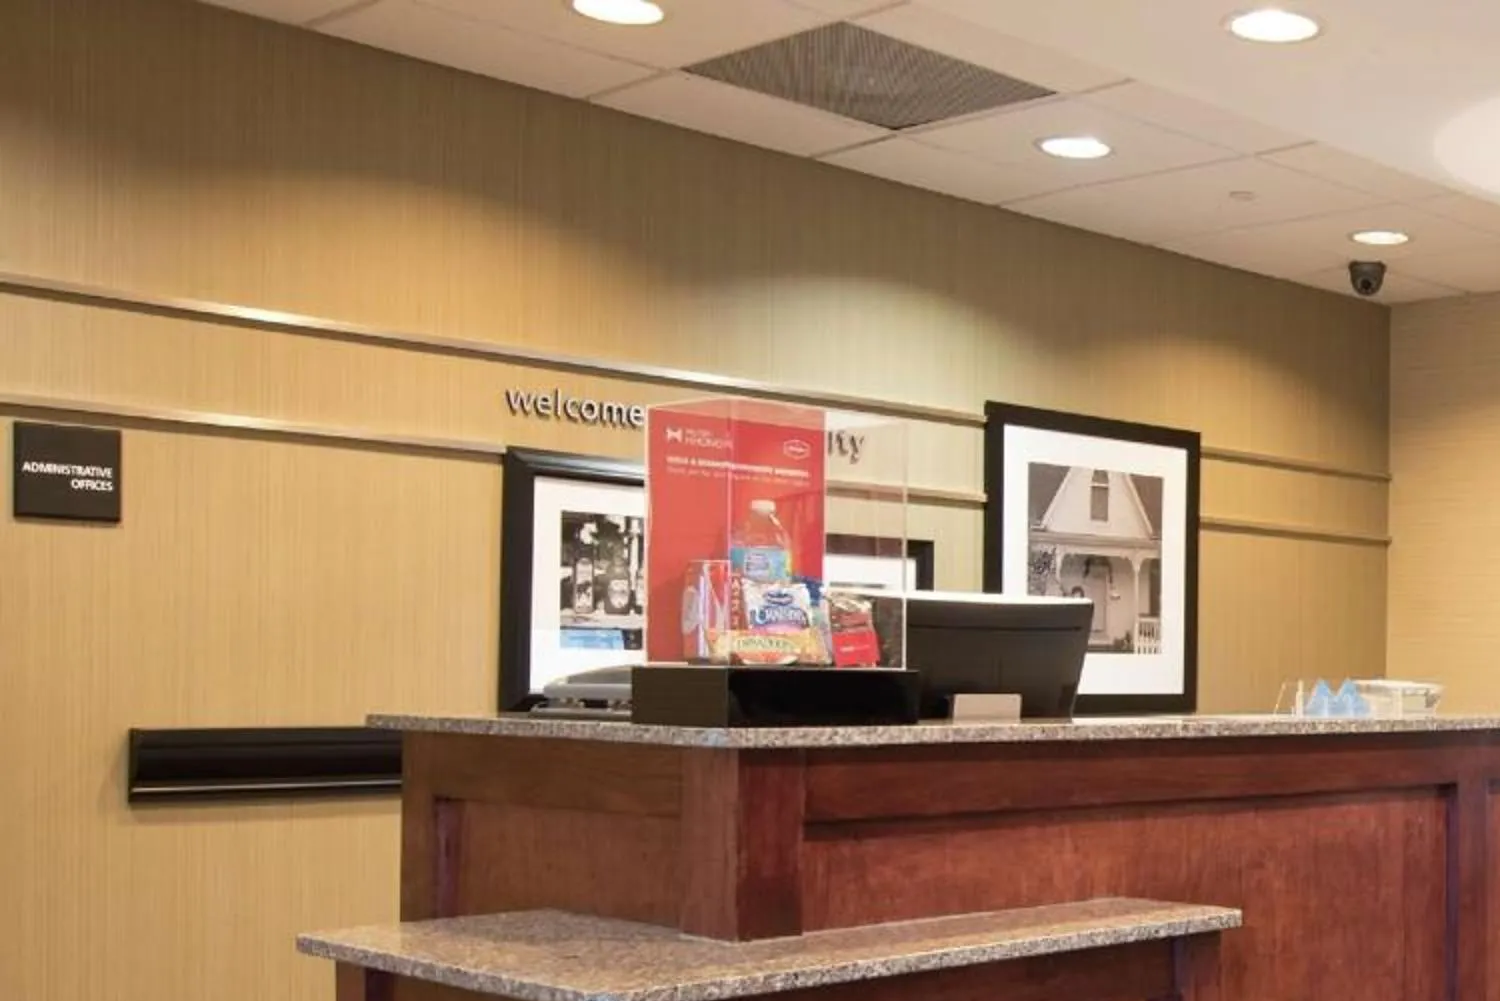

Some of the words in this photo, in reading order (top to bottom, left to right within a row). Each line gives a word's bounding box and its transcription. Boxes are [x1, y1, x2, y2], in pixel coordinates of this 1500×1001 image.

[505, 388, 646, 428] welcome
[22, 461, 113, 478] ADMINISTRATIVE
[71, 479, 113, 491] OFFICES
